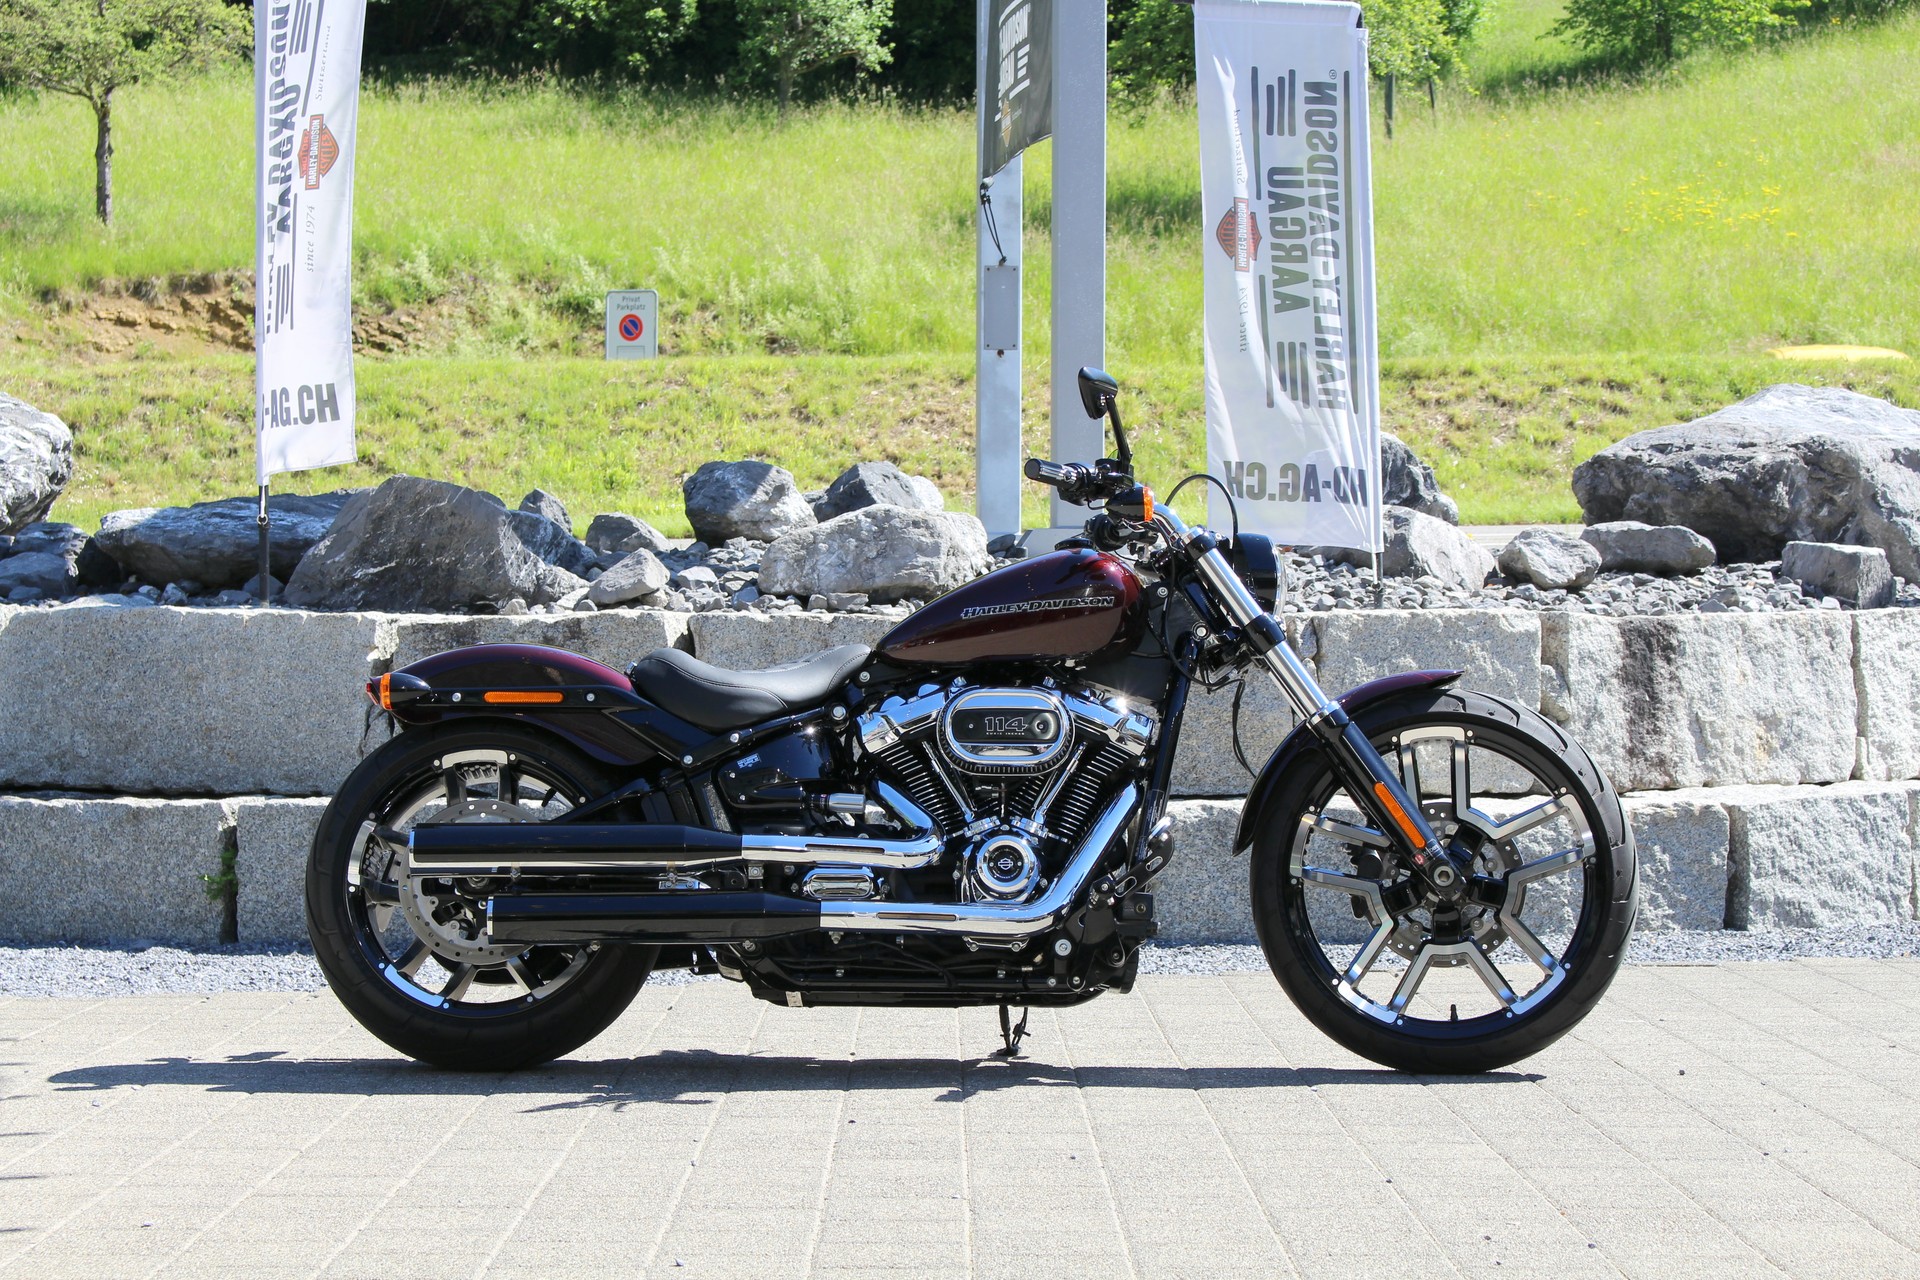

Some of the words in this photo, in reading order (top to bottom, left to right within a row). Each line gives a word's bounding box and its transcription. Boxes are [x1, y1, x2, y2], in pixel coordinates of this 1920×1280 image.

[307, 119, 321, 186] HARLEY-DAVIDSON
[305, 205, 316, 236] 1974
[304, 240, 315, 273] since
[261, 382, 341, 432] -AG.CH
[960, 596, 1115, 619] HARLEY-DAVIDSON
[984, 716, 1029, 732] 114
